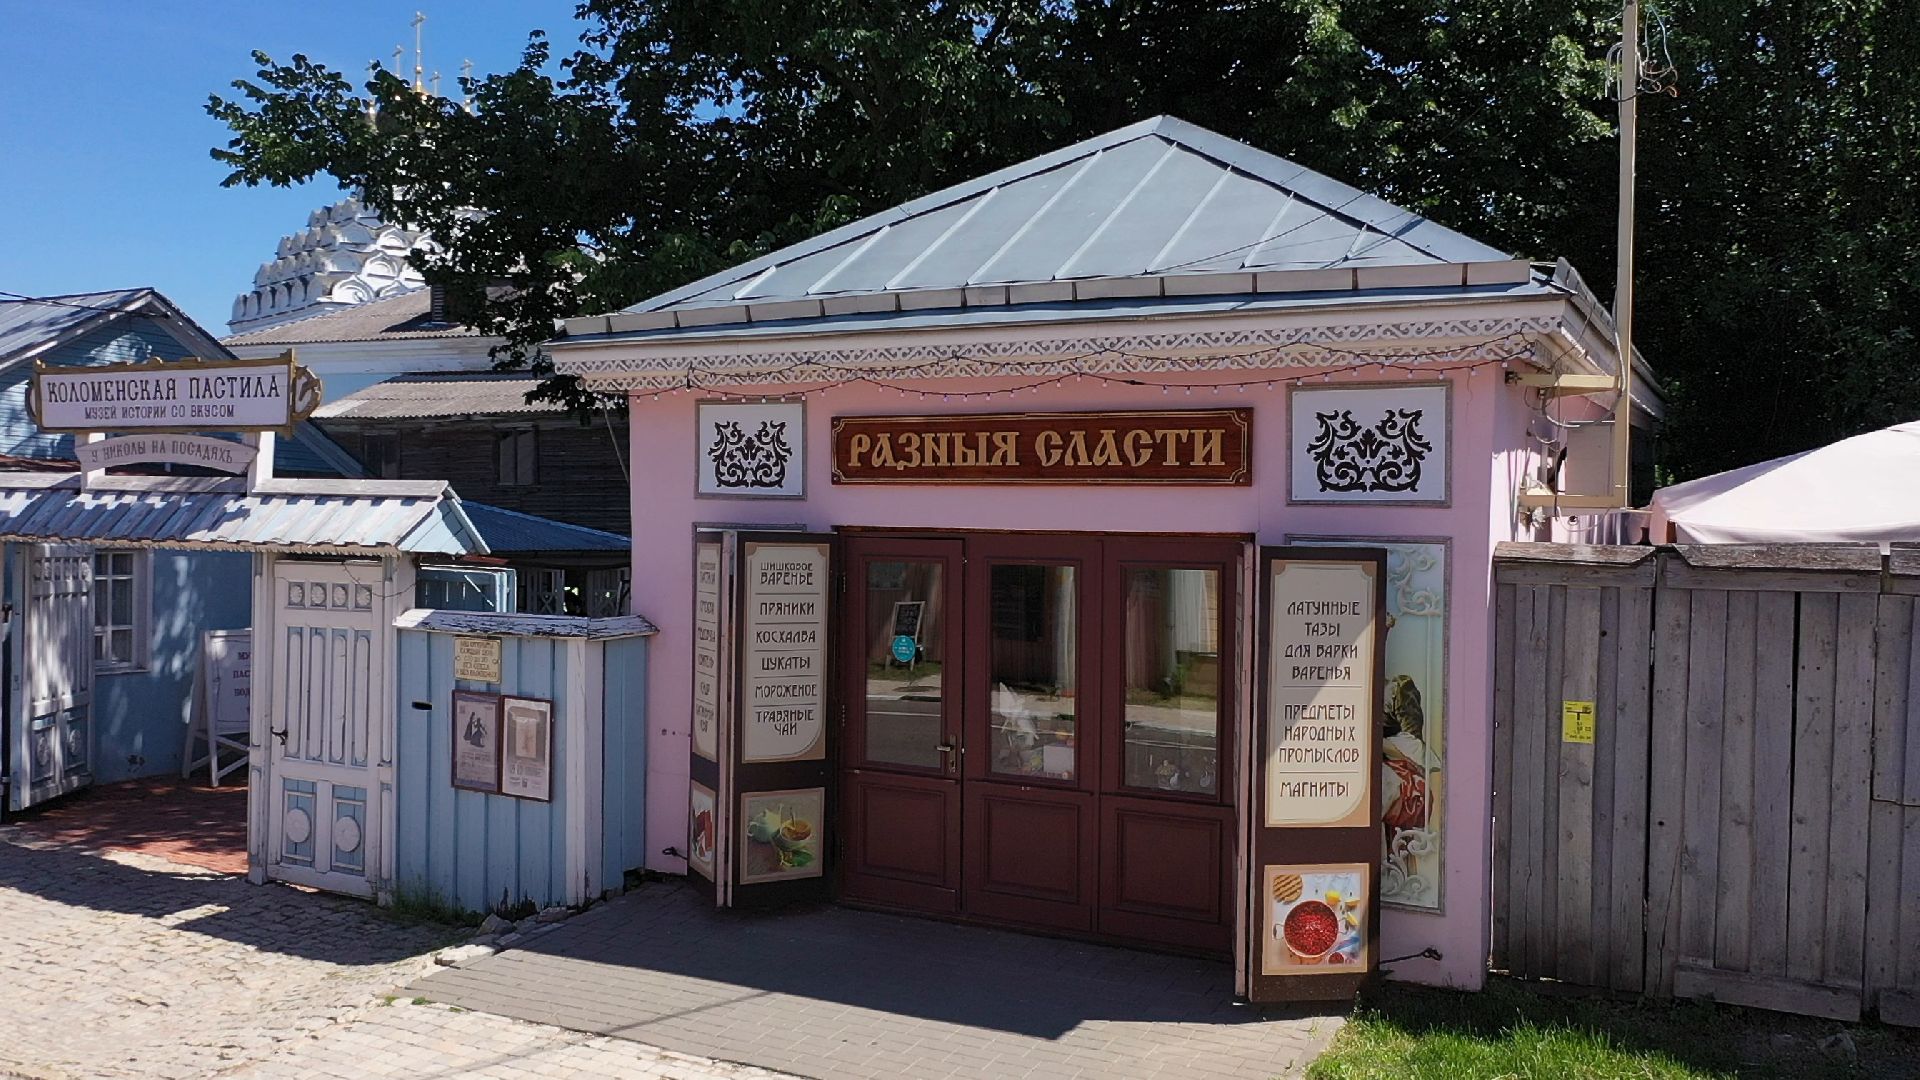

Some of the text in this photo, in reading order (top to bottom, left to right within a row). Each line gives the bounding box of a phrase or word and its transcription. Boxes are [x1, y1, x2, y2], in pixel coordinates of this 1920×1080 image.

[47, 375, 281, 403] КОЛОМЕНСКАЯ ПАСТИЛА
[85, 404, 235, 420] МУЗЕЙ ИСТОРИИ СО ВКУСОМ
[92, 450, 98, 462] У
[103, 440, 146, 461] НИКОЛЫ
[152, 440, 166, 454] НА
[847, 428, 1226, 471] РАЗНЫЯ СЛАСТИ
[760, 562, 813, 572] ШИШКОВОЕ
[760, 572, 813, 586] ВАРЕНЬЕ
[759, 602, 815, 616] ПРЯНИКИ
[1287, 601, 1360, 616] ЛАТУННЫЕ
[756, 630, 816, 644] КОСХАЛВА
[1304, 622, 1341, 637] ТАЗЫ
[1284, 644, 1358, 659] ДЛЯ ВАРКИ
[761, 656, 810, 671] ЦУКАТЫ
[1292, 665, 1351, 681] ВАРЕНЬЯ
[755, 684, 817, 699] МОРОЖЕНОЕ
[756, 709, 814, 723] ТРАВЯНЫЕ
[1284, 704, 1355, 720] ПРЕДМЕТЫ
[1284, 726, 1355, 742] НАРОДНЫХ
[1279, 748, 1360, 764] ПРОМЫСЛОВ
[1280, 781, 1349, 798] МАГНИТЫ
